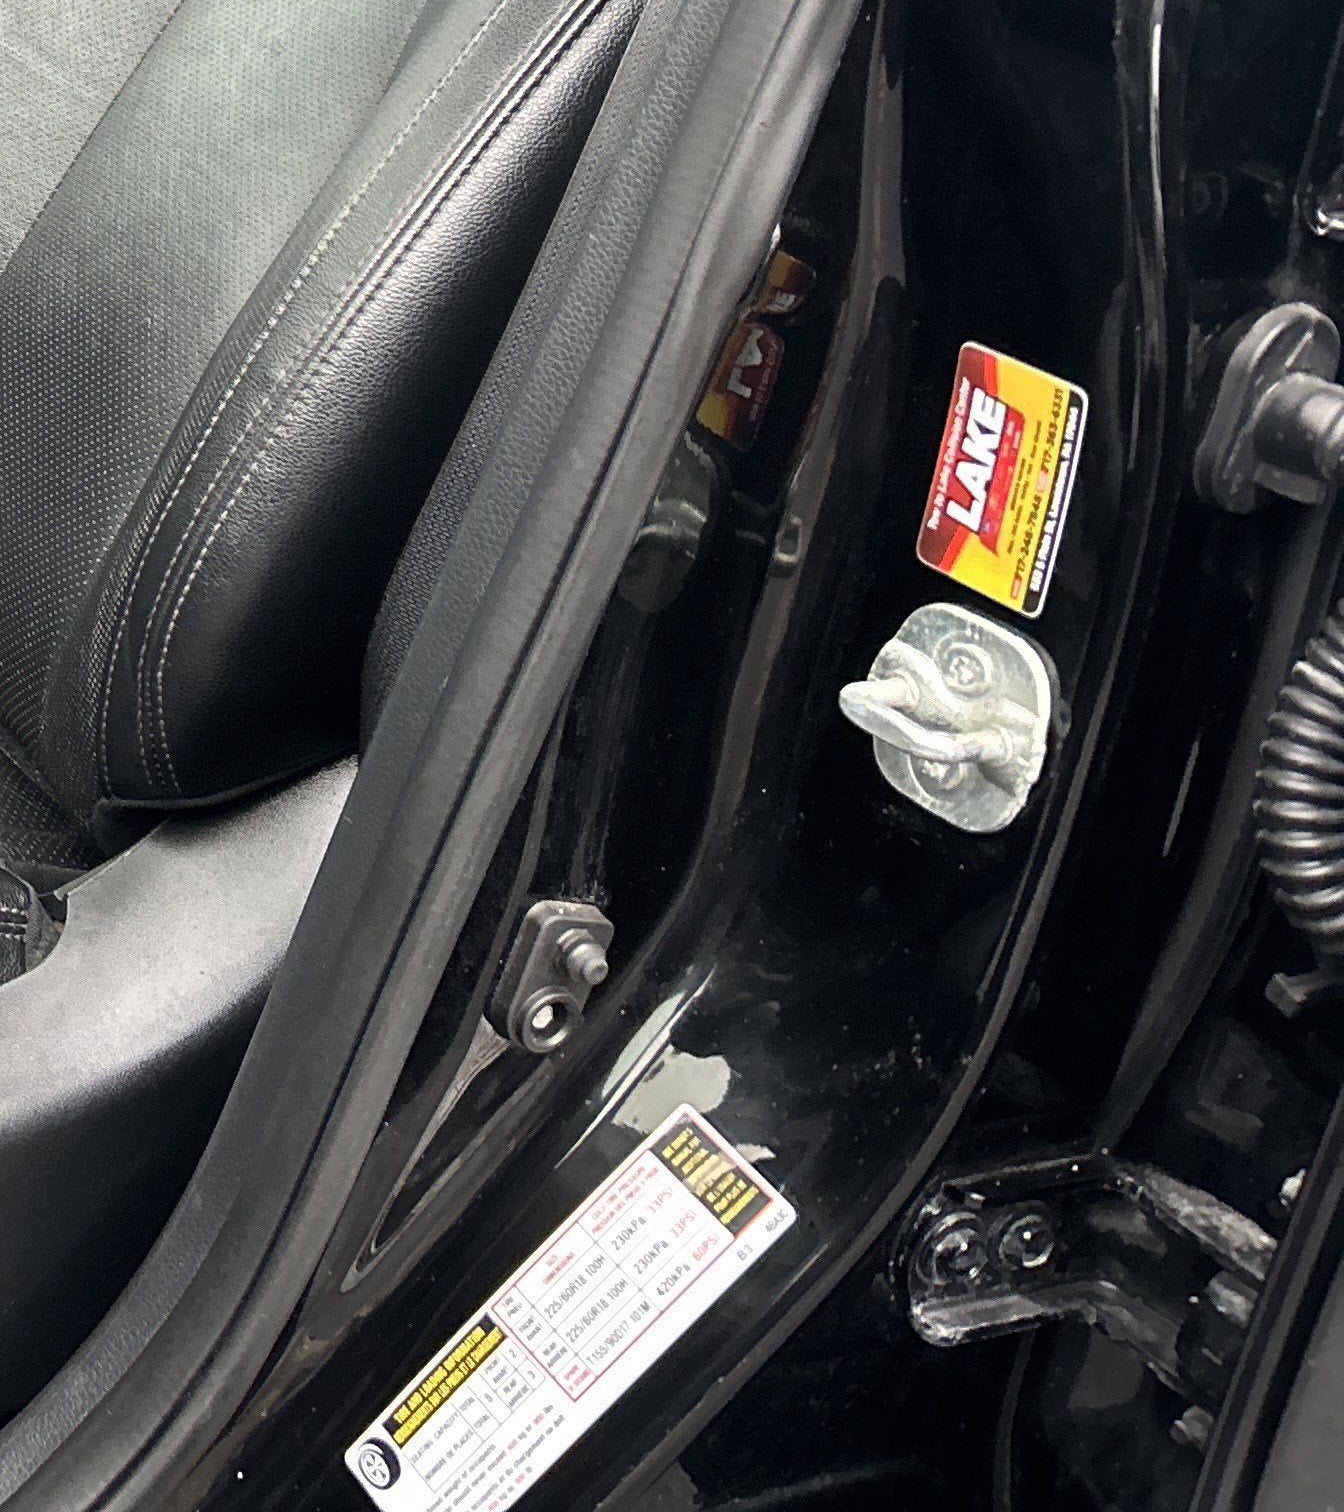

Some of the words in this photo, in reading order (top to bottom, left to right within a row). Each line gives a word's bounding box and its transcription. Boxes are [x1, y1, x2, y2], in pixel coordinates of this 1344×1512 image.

[946, 387, 1007, 532] LAKE
[611, 1216, 646, 1250] 230kPa
[634, 1240, 669, 1274] 230kPa
[544, 1275, 587, 1319] 225/60R18
[657, 1263, 691, 1296] 420kPa
[566, 1298, 609, 1342] 225/60R18
